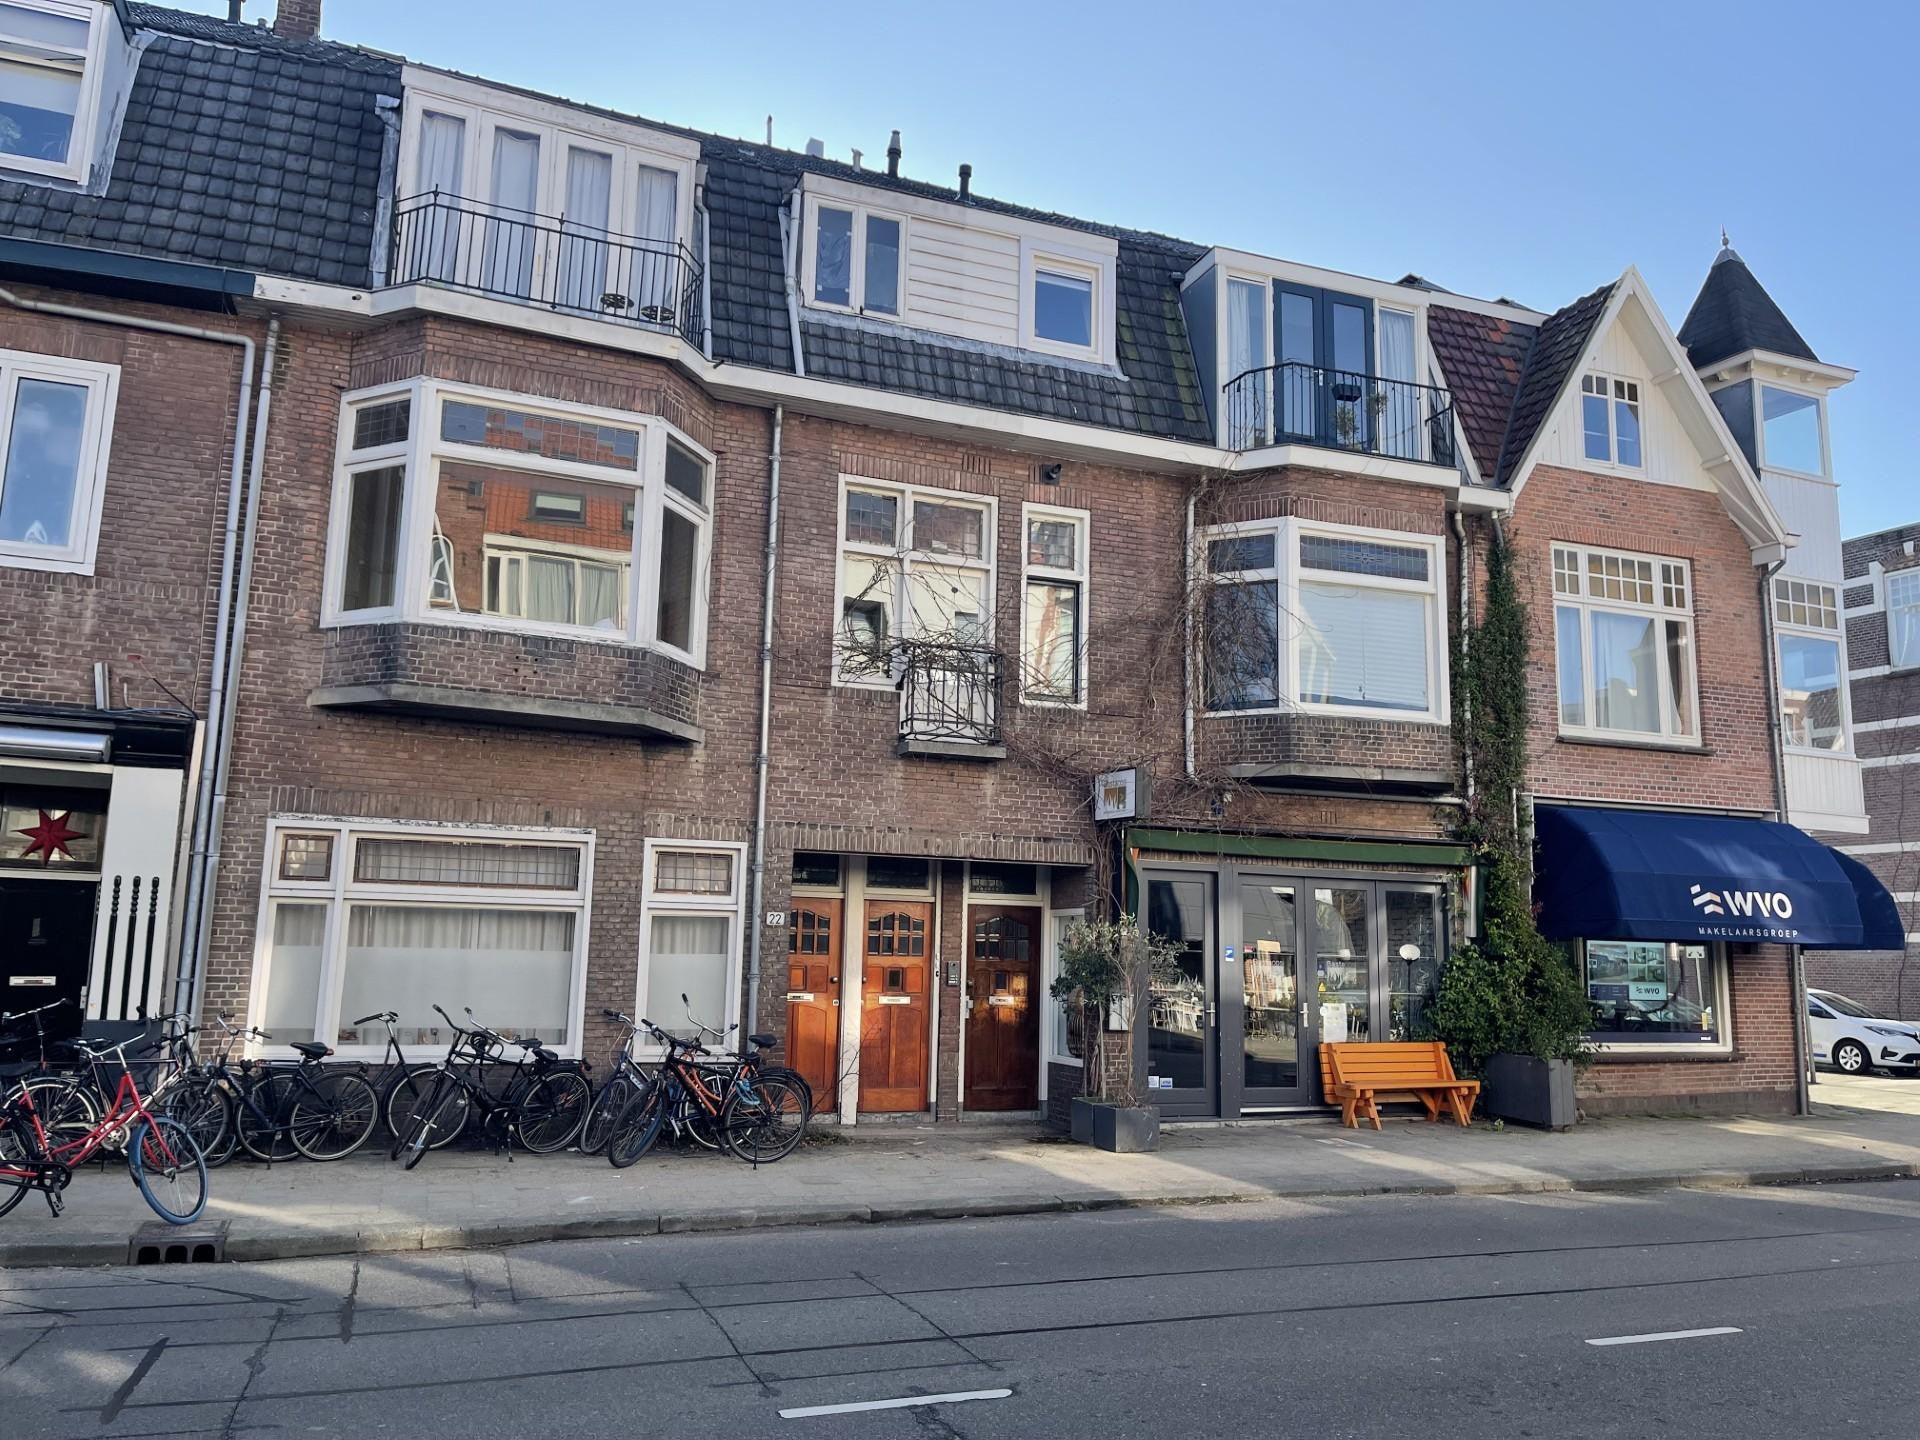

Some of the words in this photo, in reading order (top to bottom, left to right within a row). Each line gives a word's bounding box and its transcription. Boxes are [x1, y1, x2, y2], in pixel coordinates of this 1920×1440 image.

[1723, 891, 1792, 919] WVO
[769, 913, 781, 925] 22
[1699, 927, 1798, 938] MAKELAARSGROEP
[1644, 987, 1660, 995] WVO
